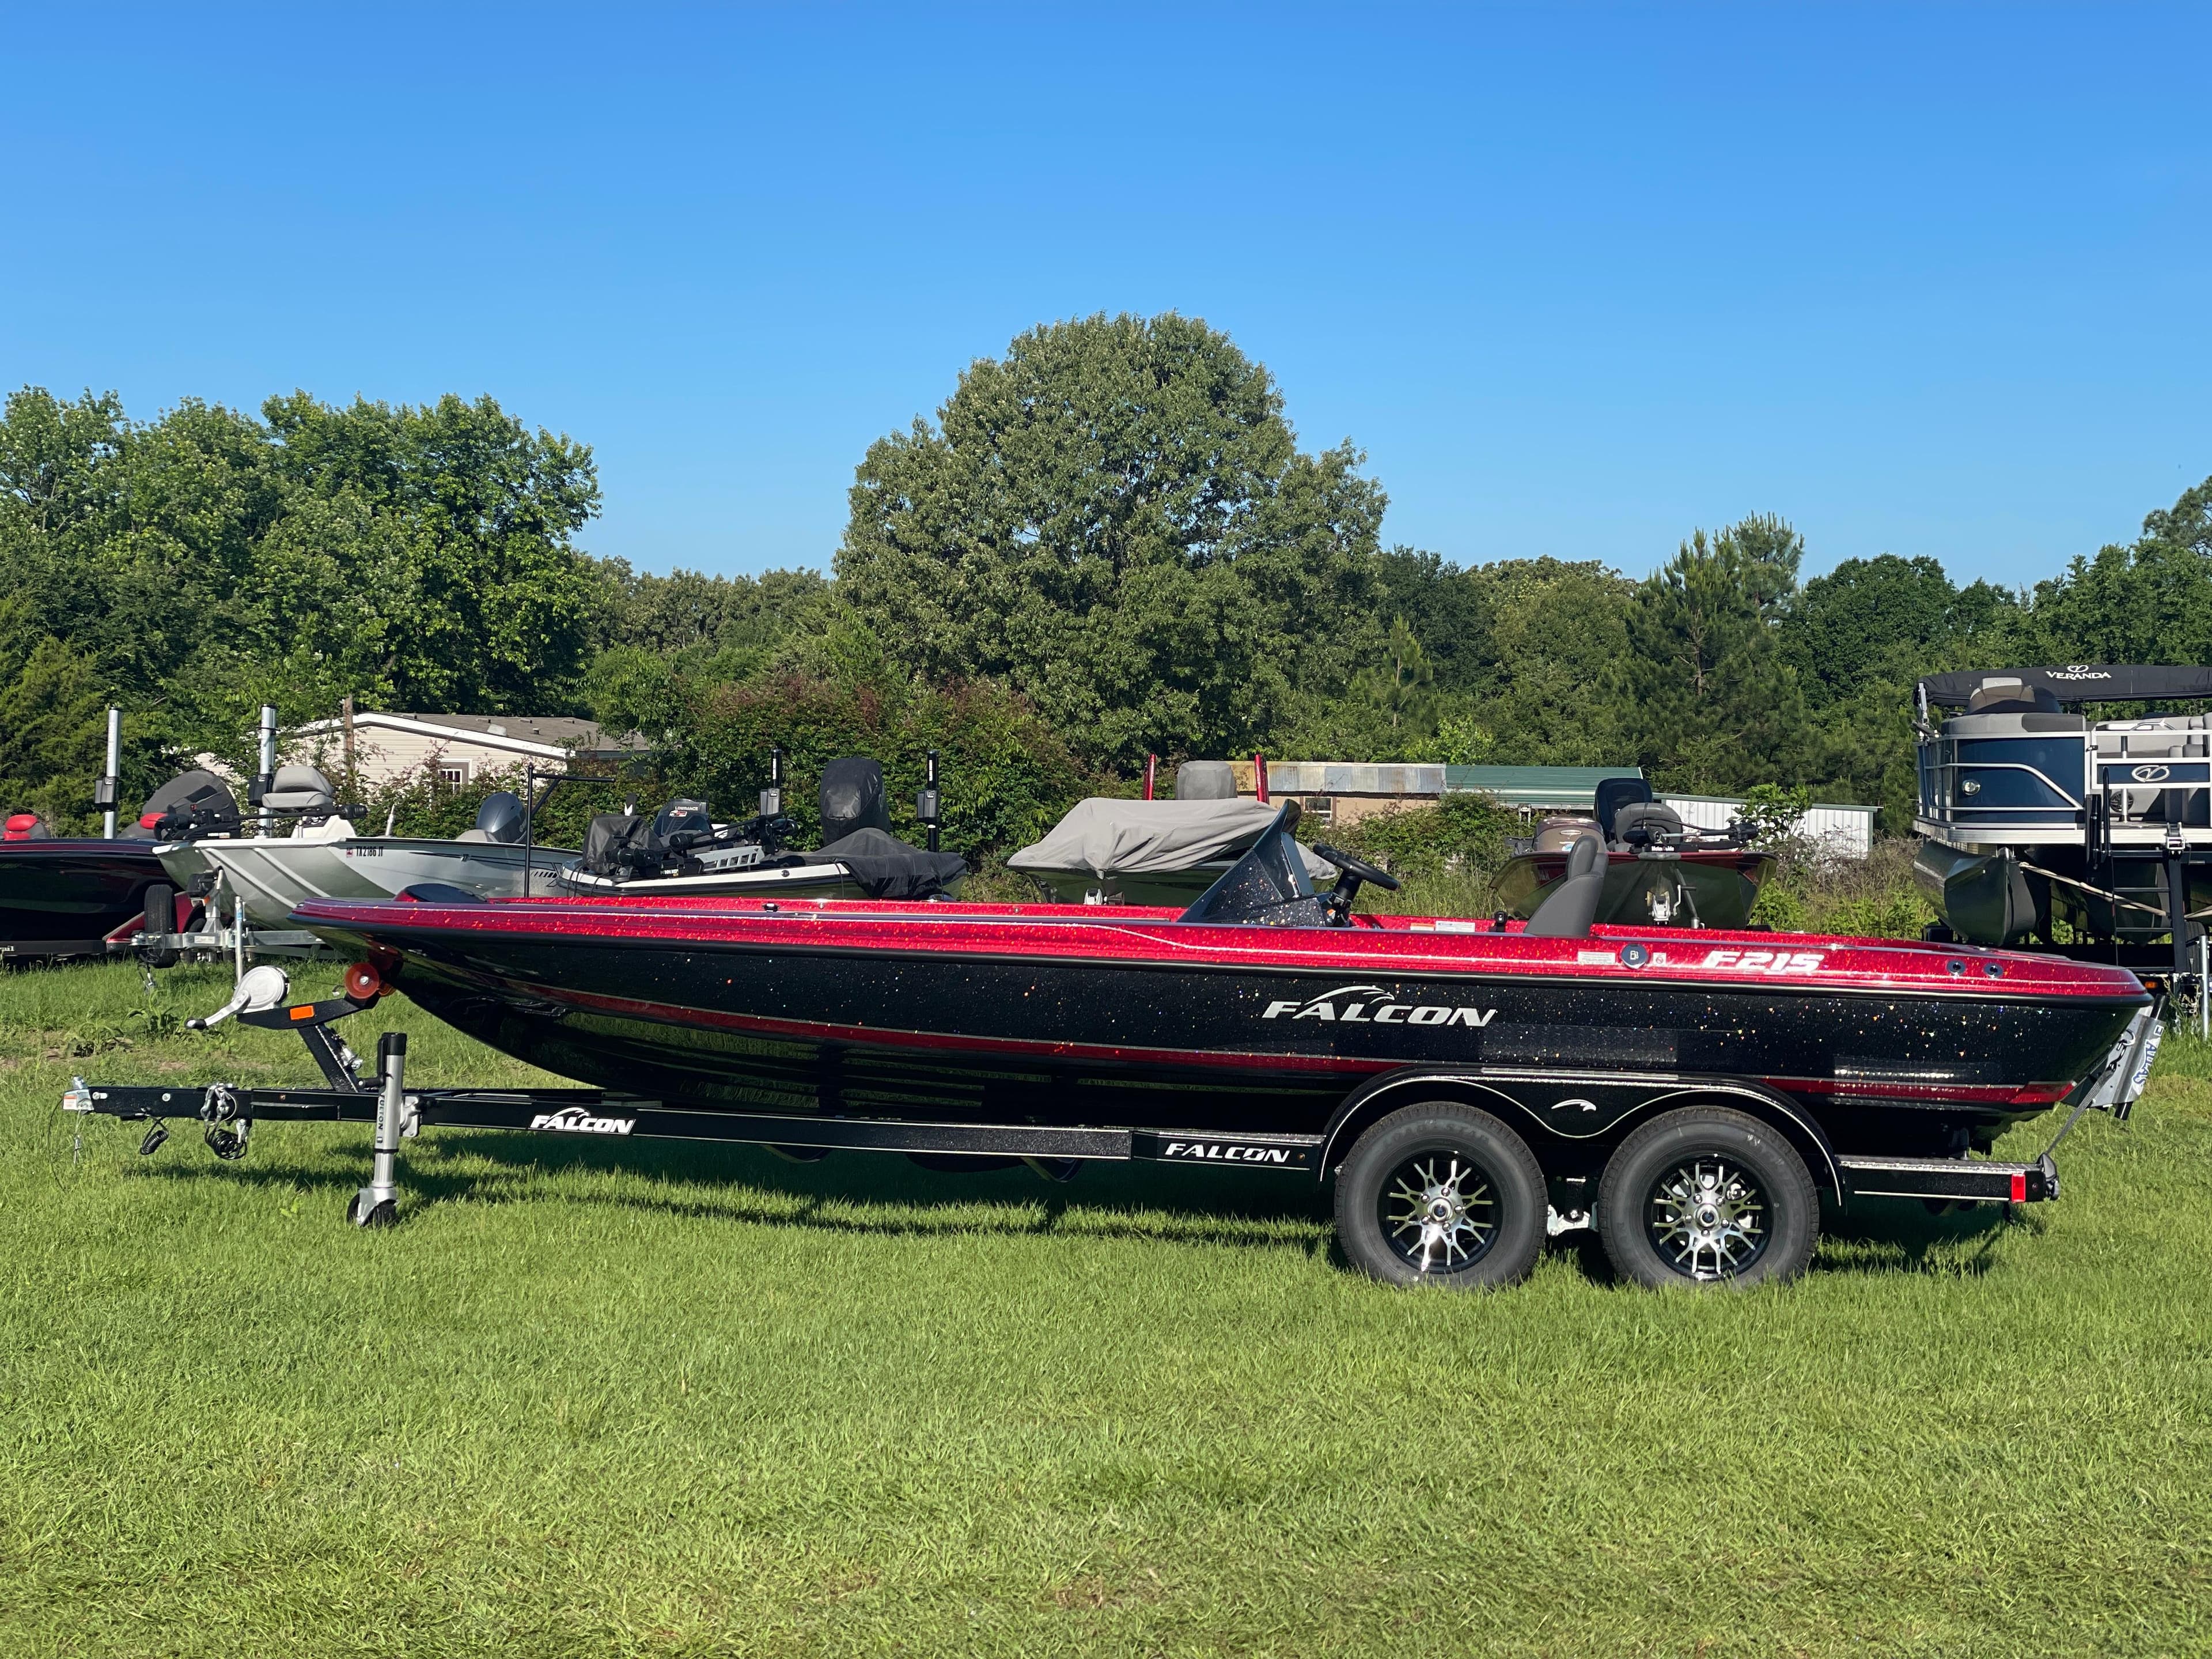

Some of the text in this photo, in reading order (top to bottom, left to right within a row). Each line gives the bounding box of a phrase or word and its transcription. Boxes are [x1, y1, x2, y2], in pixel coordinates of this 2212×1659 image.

[2046, 671, 2112, 680] VERANDA
[1701, 950, 1825, 971] F215
[1262, 1001, 1498, 1027] FALCON
[529, 1115, 634, 1134] FALCON
[1165, 1143, 1290, 1162] FALCON
